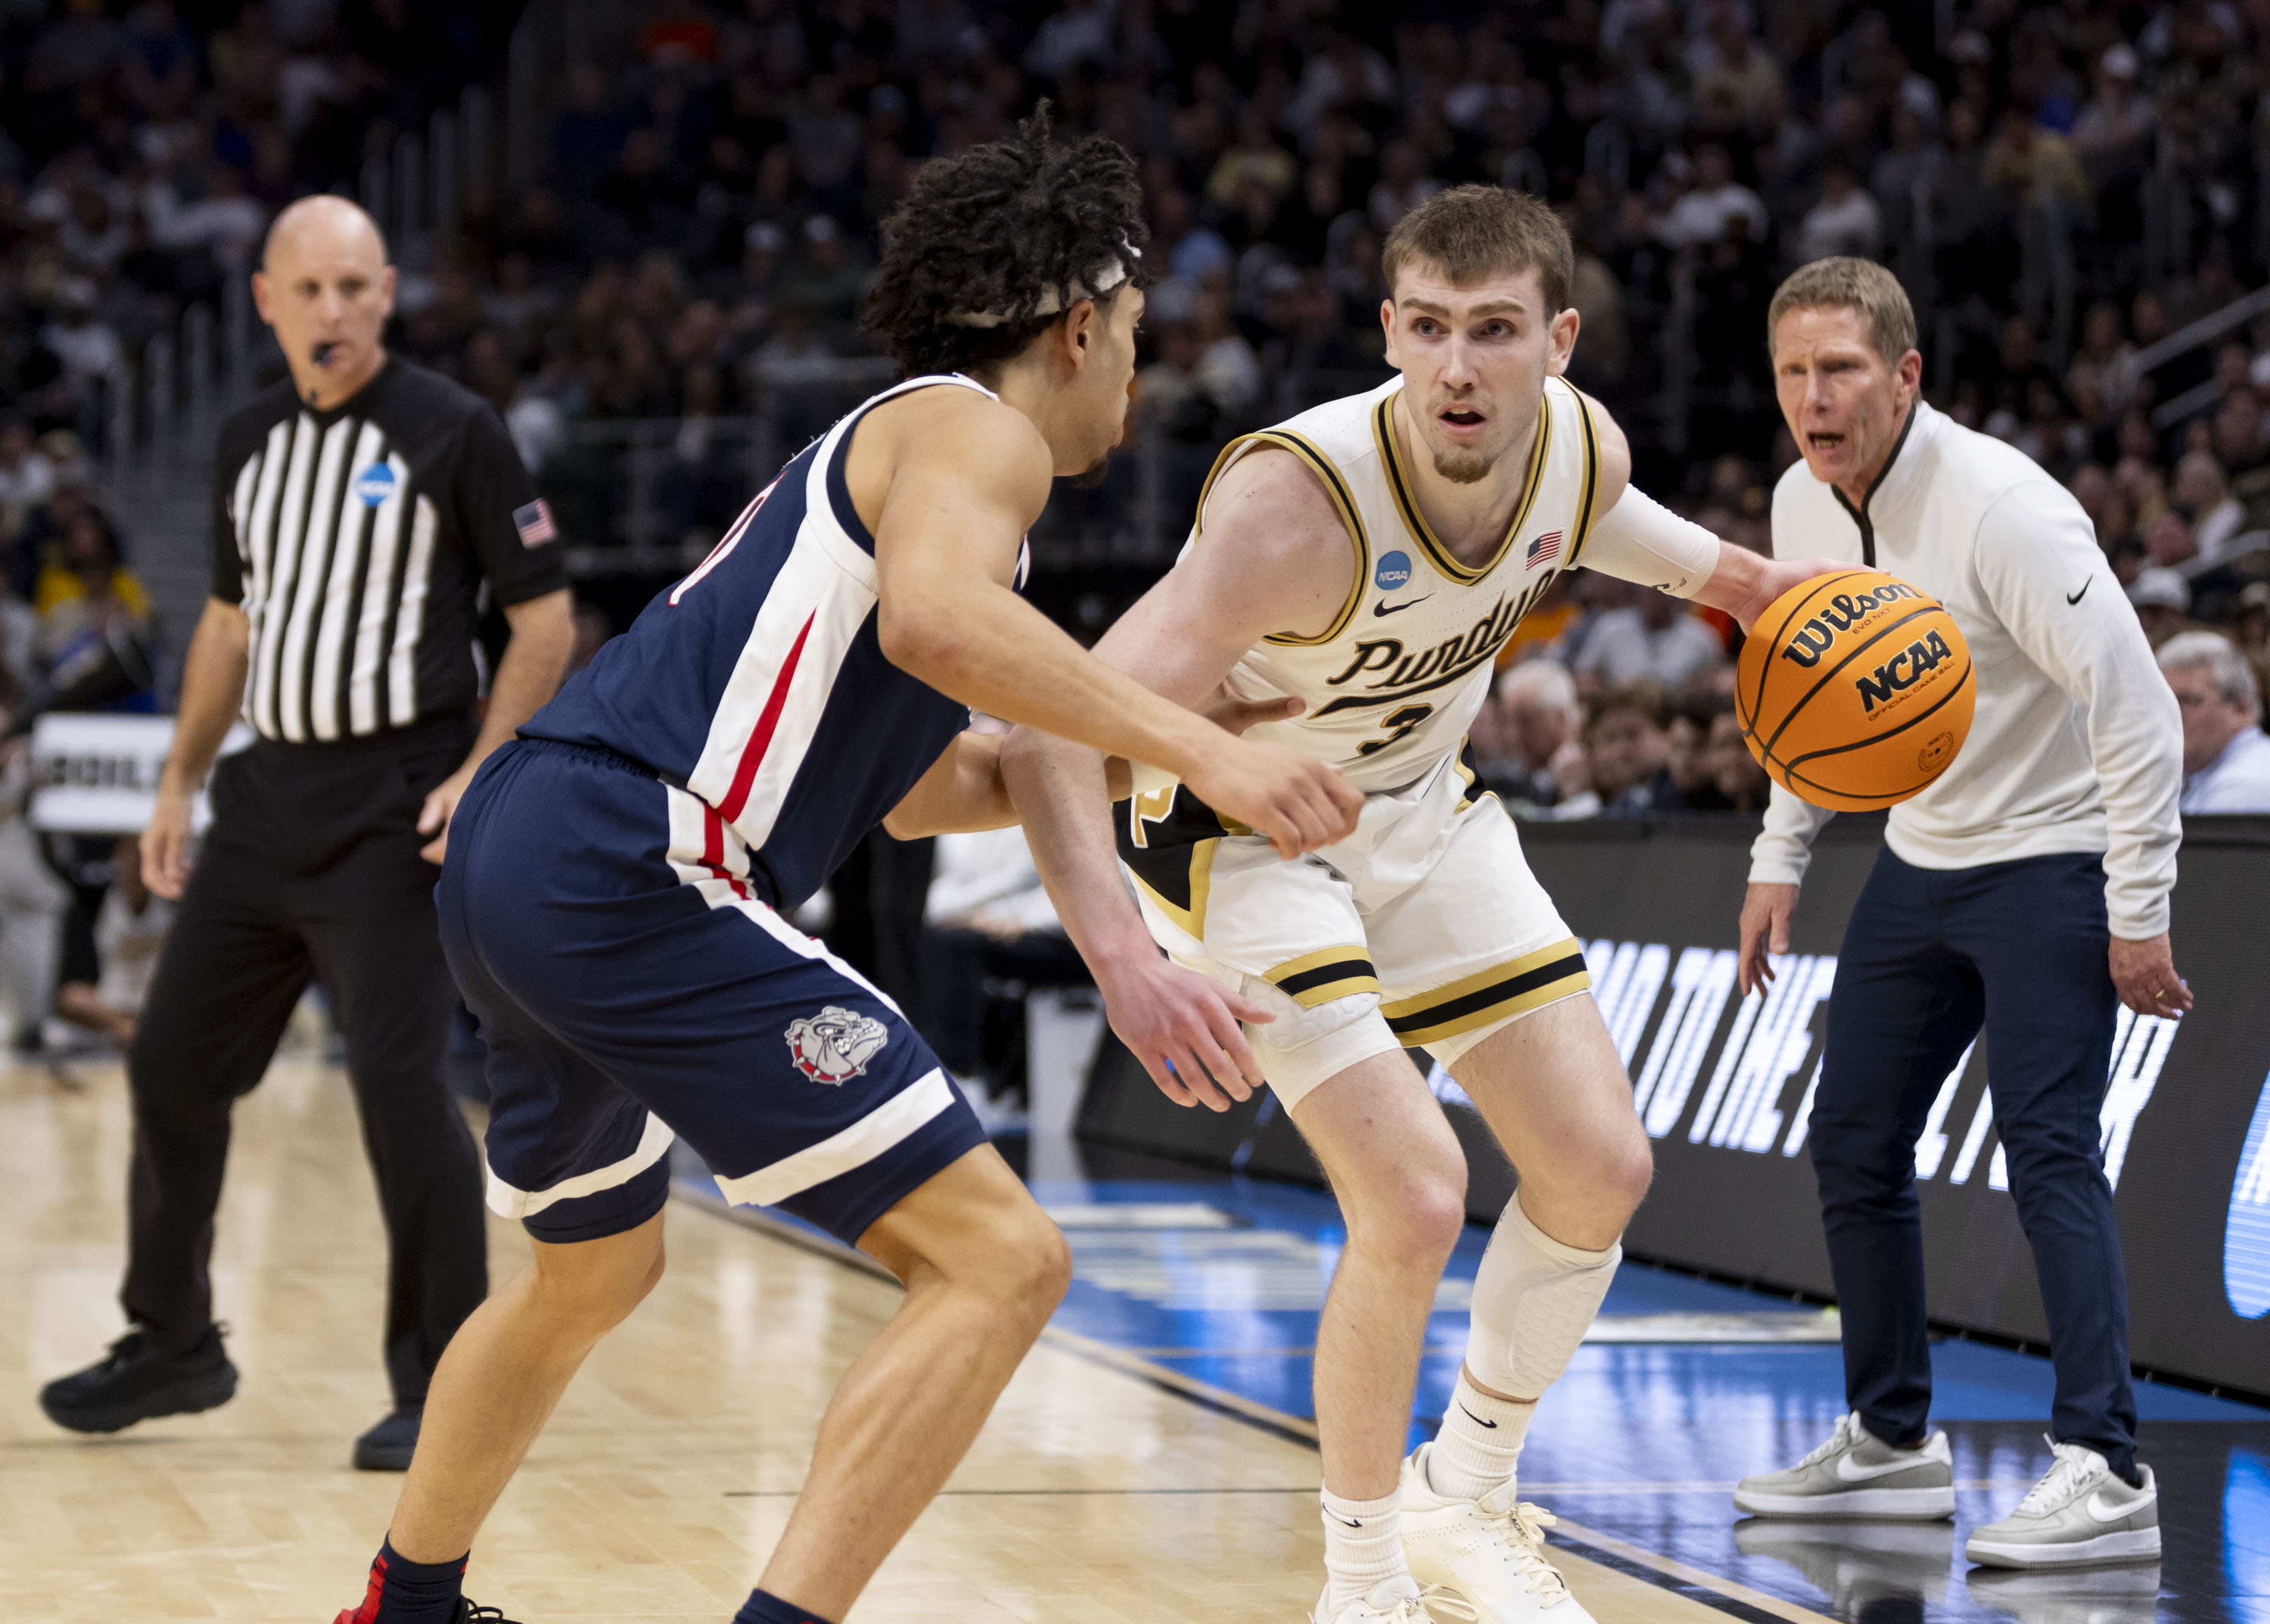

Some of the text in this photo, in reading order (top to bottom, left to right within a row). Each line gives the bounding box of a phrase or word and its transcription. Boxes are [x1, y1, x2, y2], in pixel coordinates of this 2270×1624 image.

[1378, 571, 1407, 582] NCAA
[1326, 567, 1556, 690] Purdue
[1780, 582, 1923, 667] Wilson
[1852, 619, 1872, 635] EVO
[1855, 628, 1952, 714] NCAA
[1356, 703, 1434, 758] 3
[1868, 693, 1912, 721] OFFICIAL
